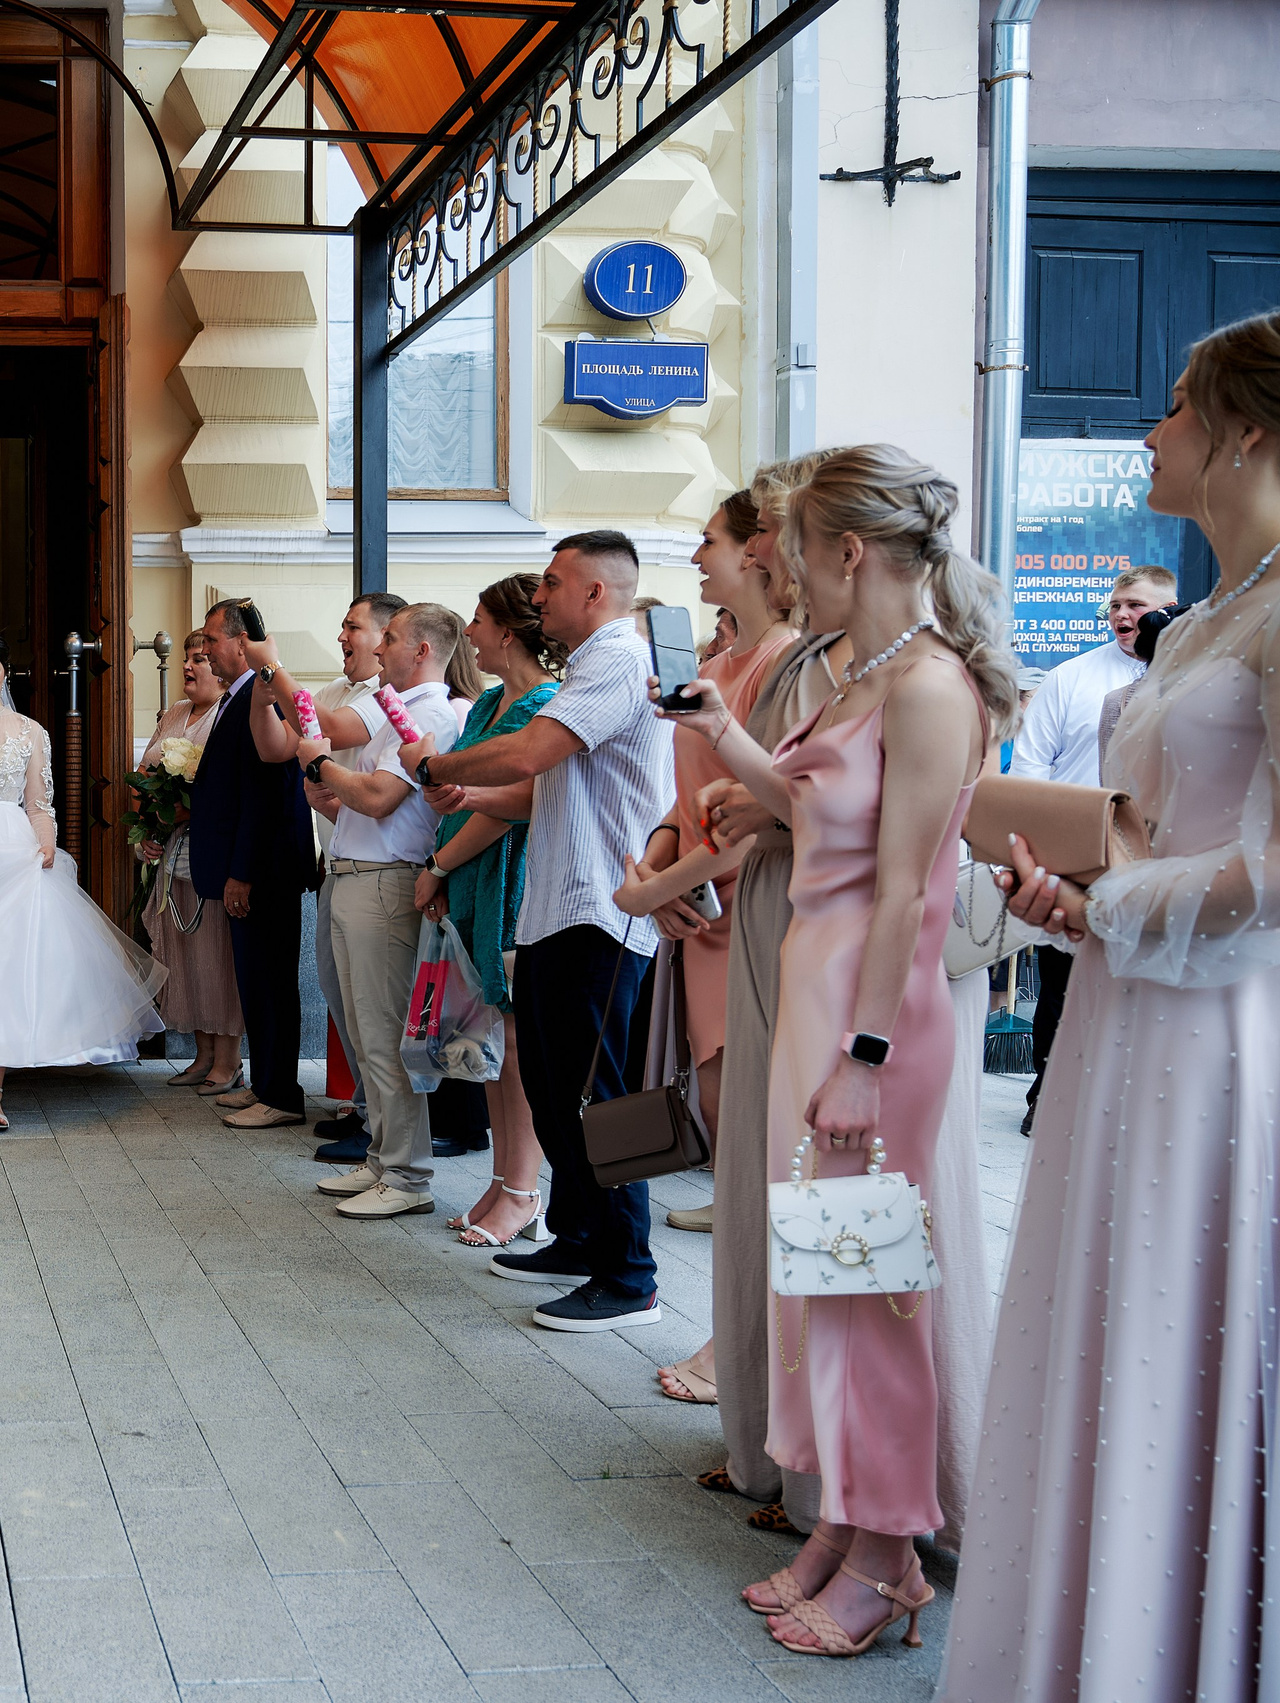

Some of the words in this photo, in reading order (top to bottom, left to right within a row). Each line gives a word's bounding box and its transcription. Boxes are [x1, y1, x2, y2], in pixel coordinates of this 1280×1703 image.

[625, 263, 653, 294] 11
[581, 363, 643, 376] ПЛОЩАДЬ
[648, 365, 699, 376] ЛЕНИНА
[624, 398, 655, 406] УЛИЦА
[1050, 554, 1088, 570] 000
[1015, 576, 1115, 588] ДИНОВРЕМЕНН
[1029, 619, 1038, 630] 3
[1040, 619, 1066, 630] 400
[1069, 620, 1095, 630] 000
[1097, 620, 1112, 631] РУ
[1047, 633, 1062, 642] ЗА
[1064, 632, 1108, 643] ПЕРВЫЙ
[1014, 643, 1030, 653] ОД
[1032, 643, 1080, 653] СЛУЖБЫ
